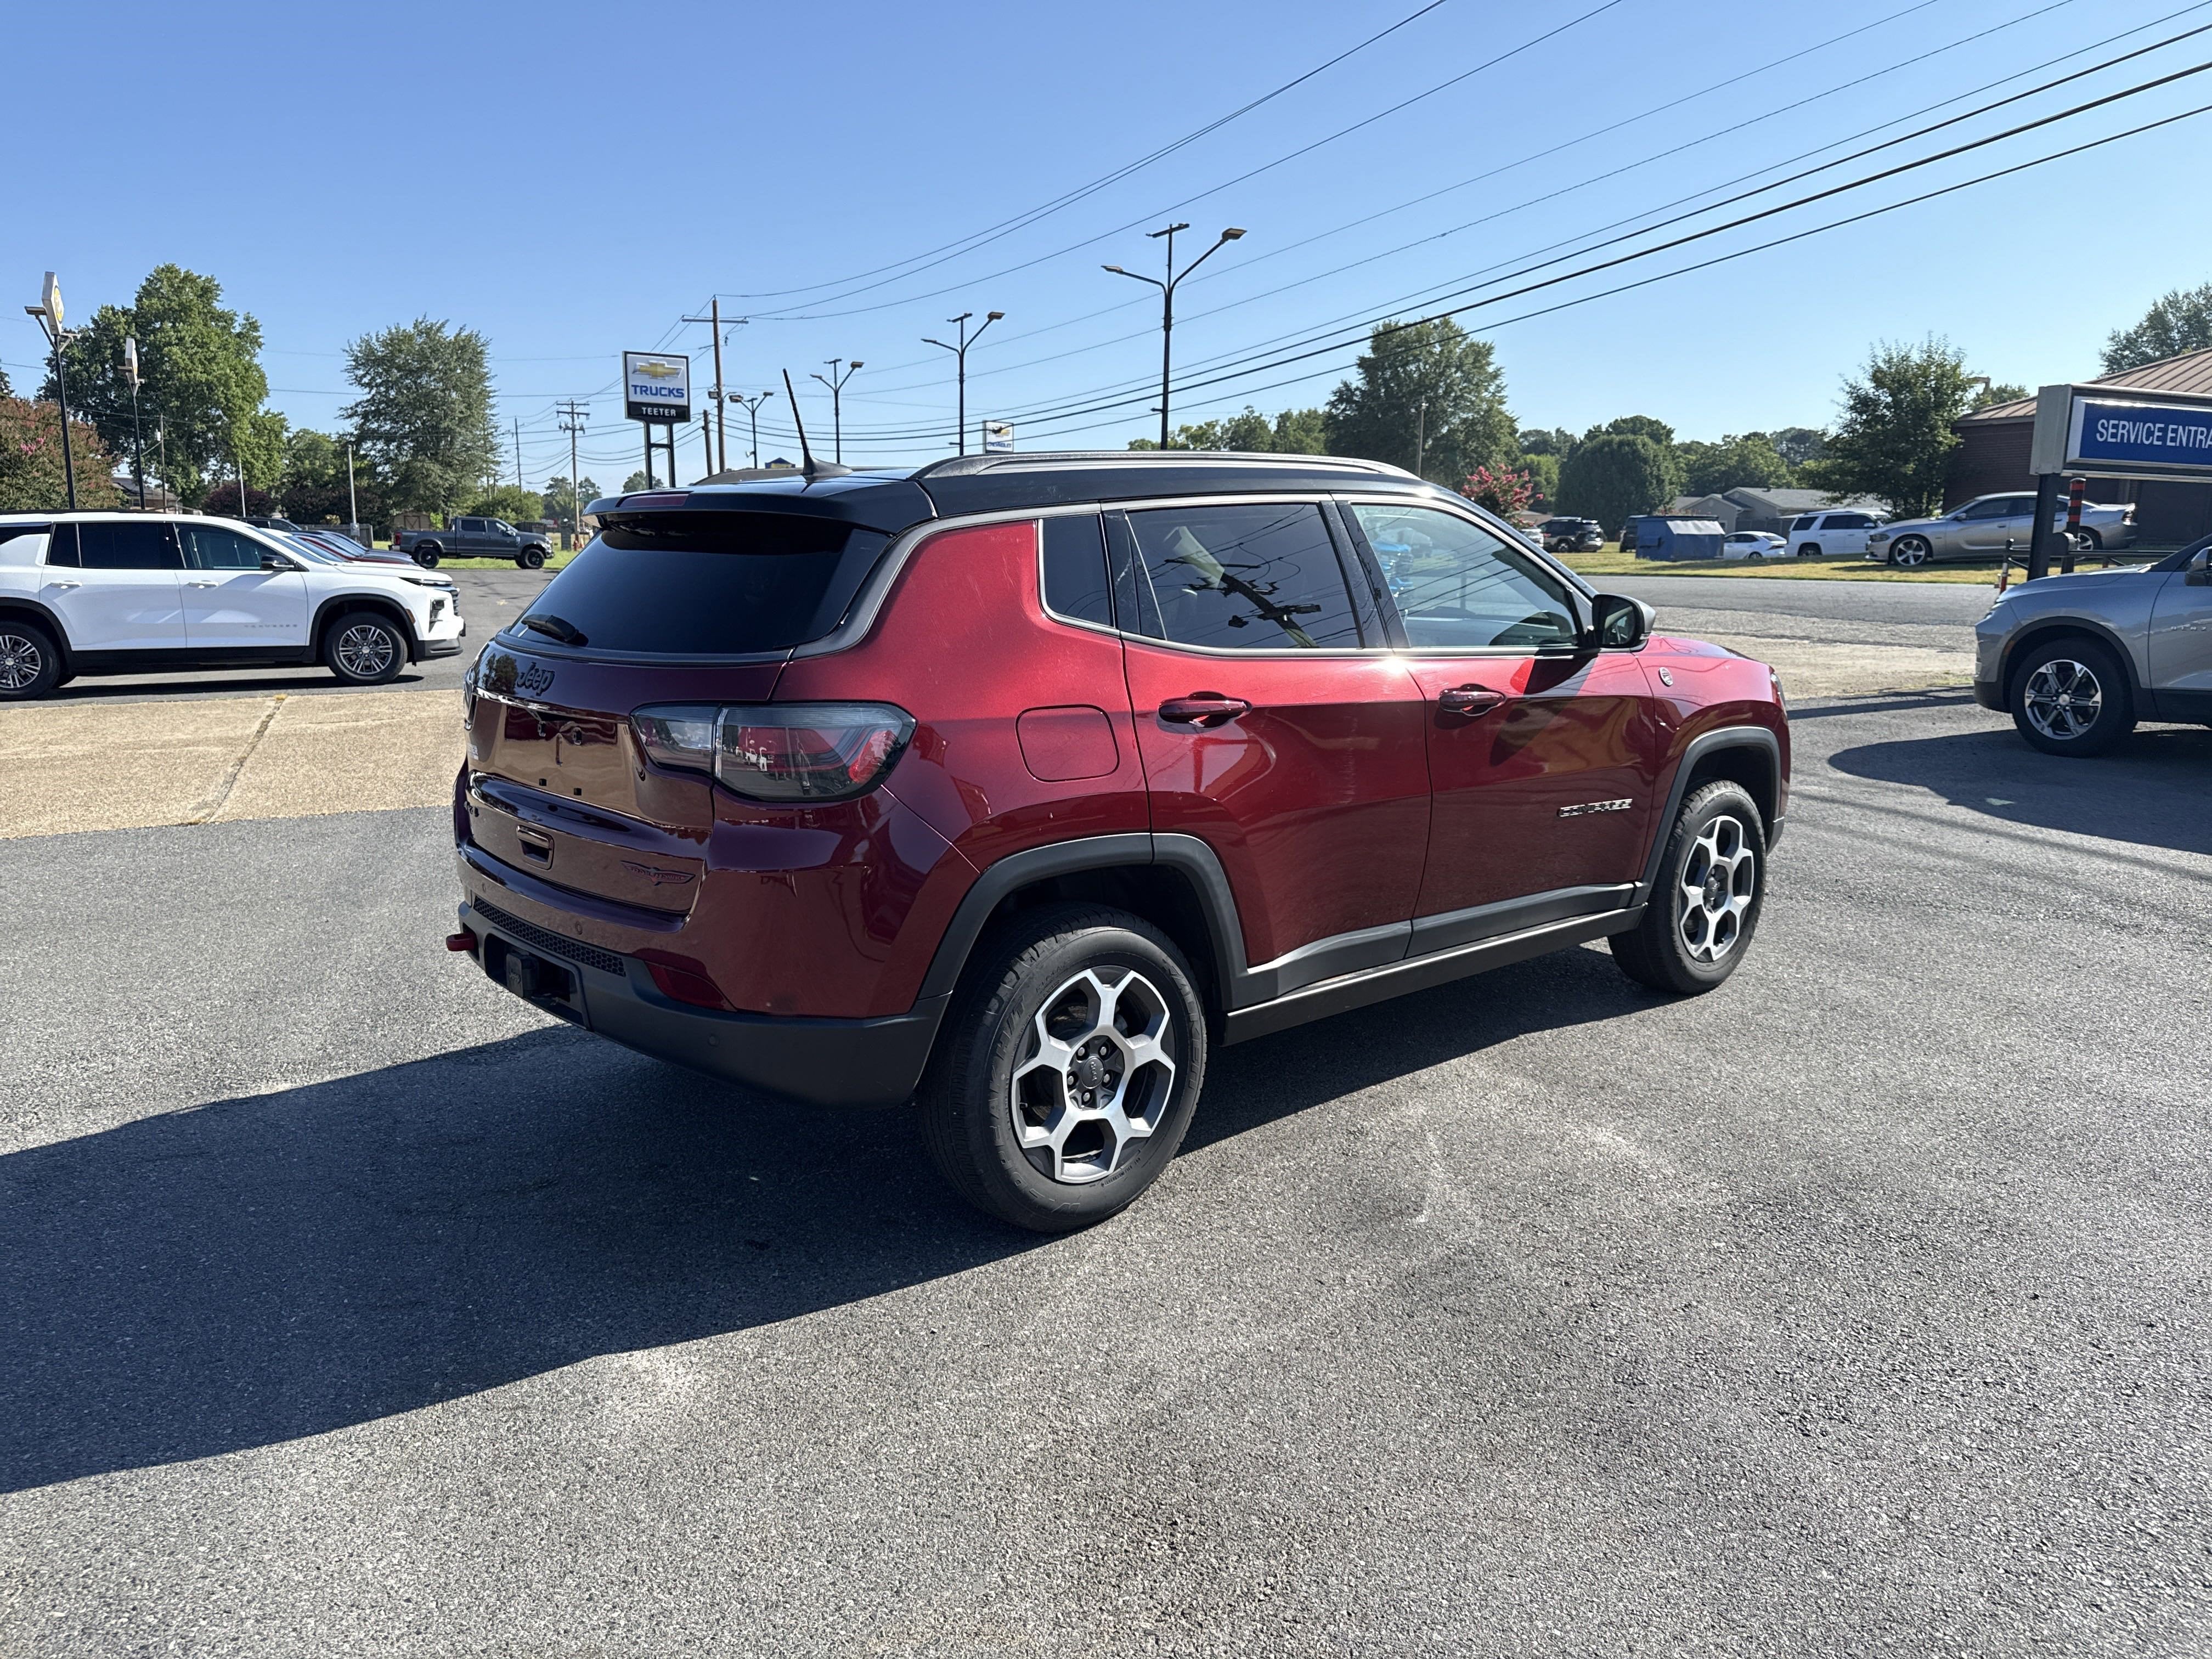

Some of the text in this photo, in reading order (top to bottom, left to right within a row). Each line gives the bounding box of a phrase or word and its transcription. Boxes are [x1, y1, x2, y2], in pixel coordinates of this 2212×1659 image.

[631, 385, 684, 398] TRUCKS
[641, 407, 676, 417] TEETER
[2096, 419, 2164, 445] SERVICE
[516, 662, 555, 696] Jeep
[1558, 798, 1633, 817] COMPASS
[988, 1064, 1080, 1214] WLDPEAK
